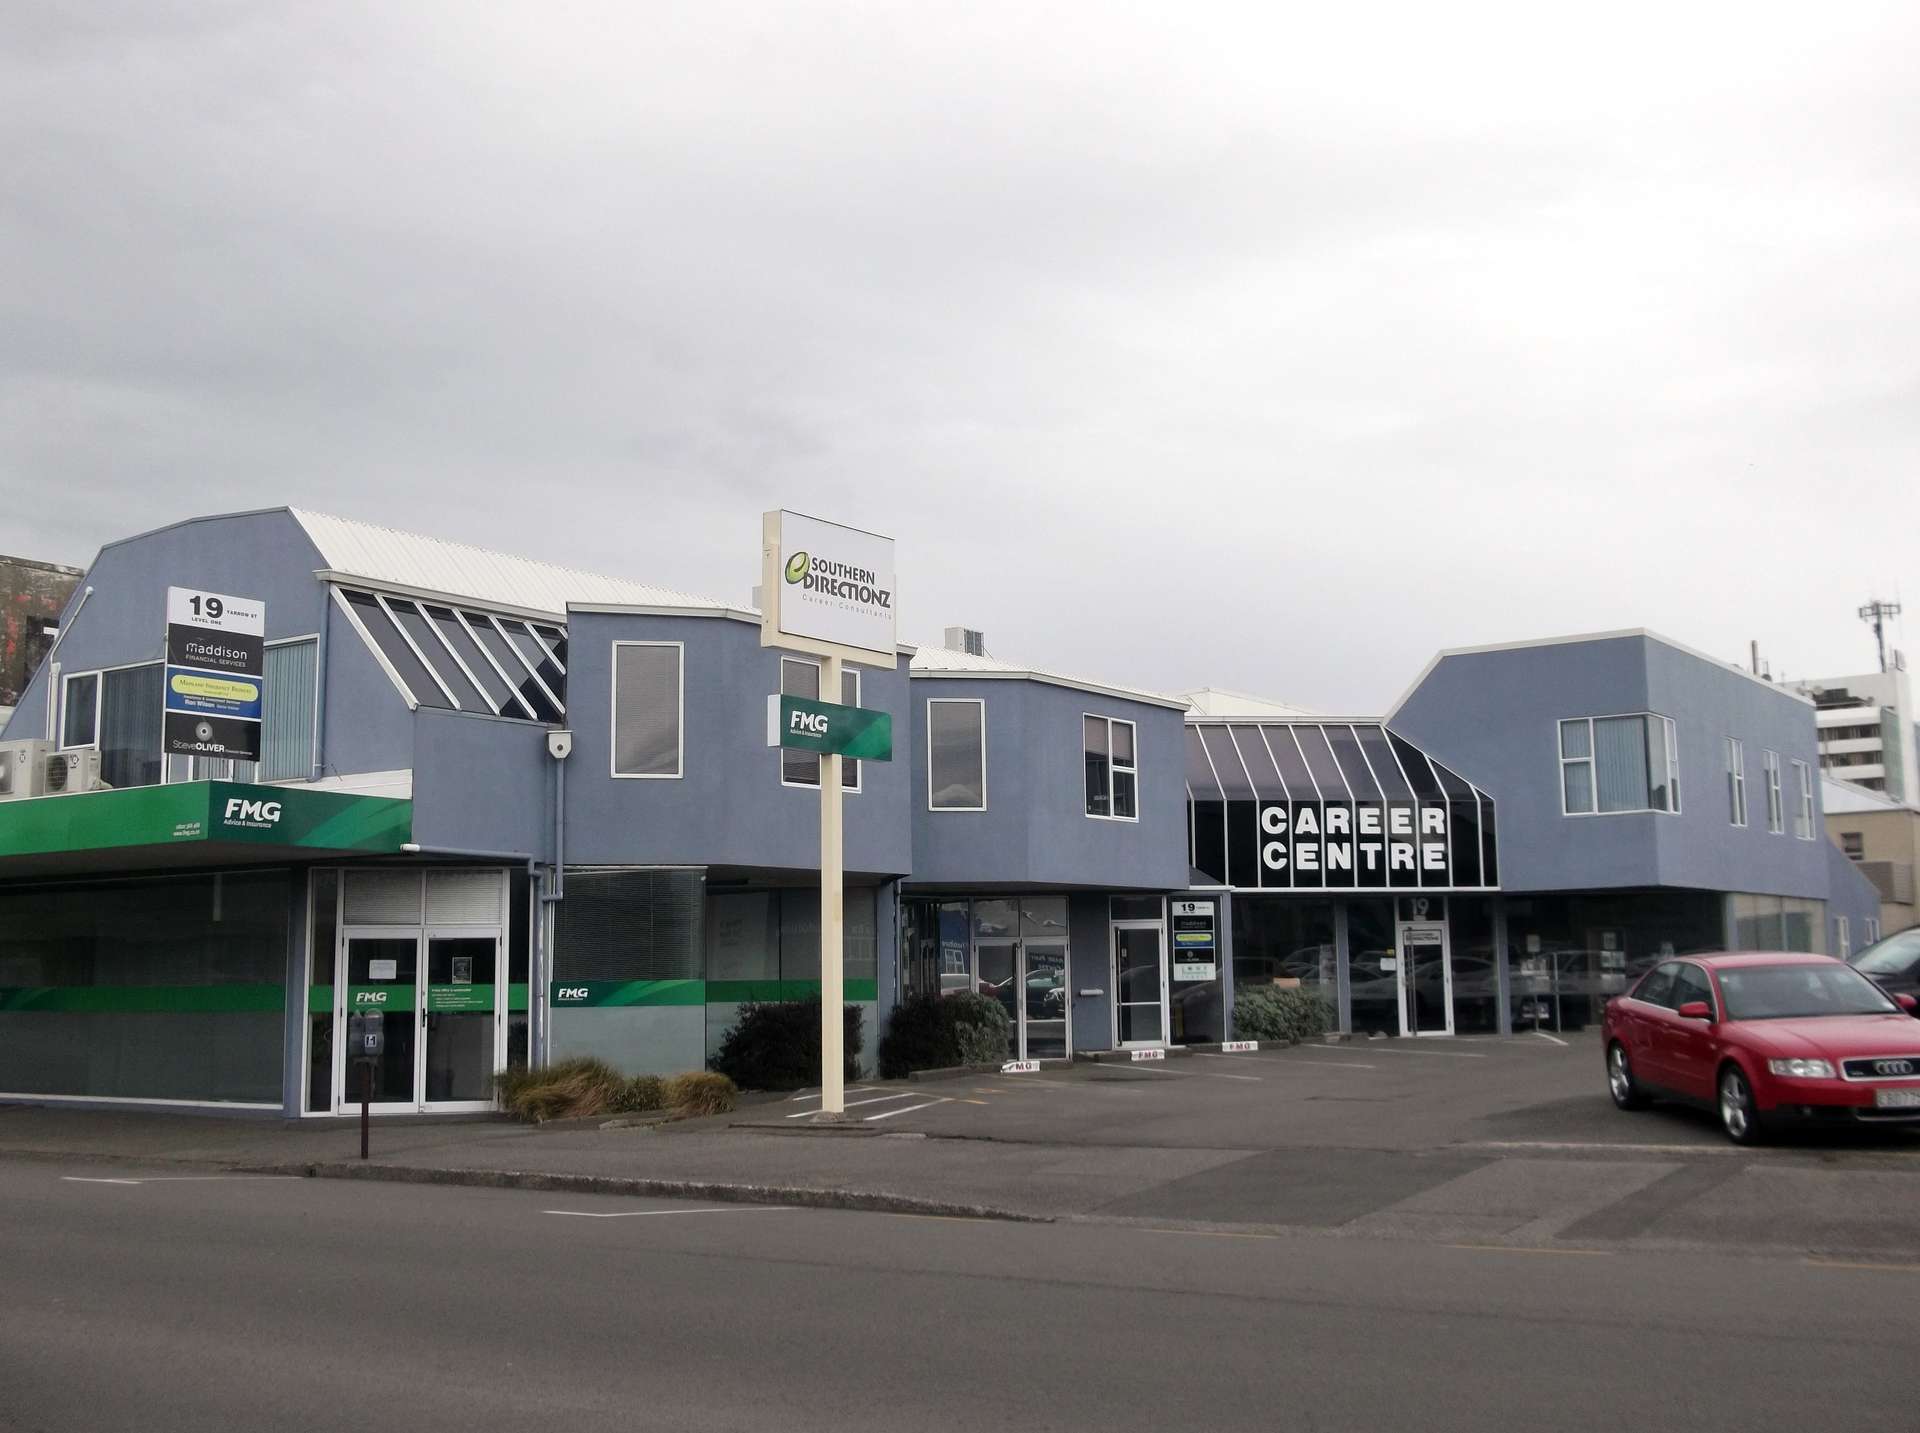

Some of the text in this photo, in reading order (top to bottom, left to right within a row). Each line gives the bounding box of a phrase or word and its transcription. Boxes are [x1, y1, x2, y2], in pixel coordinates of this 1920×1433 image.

[811, 557, 875, 585] SOUTHERN
[803, 571, 891, 608] DIRECTIONZ
[189, 595, 223, 618] 19
[226, 609, 249, 618] YARROW
[802, 593, 892, 620] Career Consultants
[191, 616, 208, 624] LEVEL
[185, 653, 246, 668] FINANCIAL SERVICES
[186, 642, 247, 660] maddison
[790, 710, 828, 733] FMG
[224, 798, 282, 822] FMG
[1261, 806, 1446, 835] CAREER
[246, 820, 272, 828] Insurance
[1262, 841, 1447, 870] CENTRE
[1181, 903, 1195, 911] 19
[355, 992, 387, 1002] FMG
[558, 988, 589, 998] FMG
